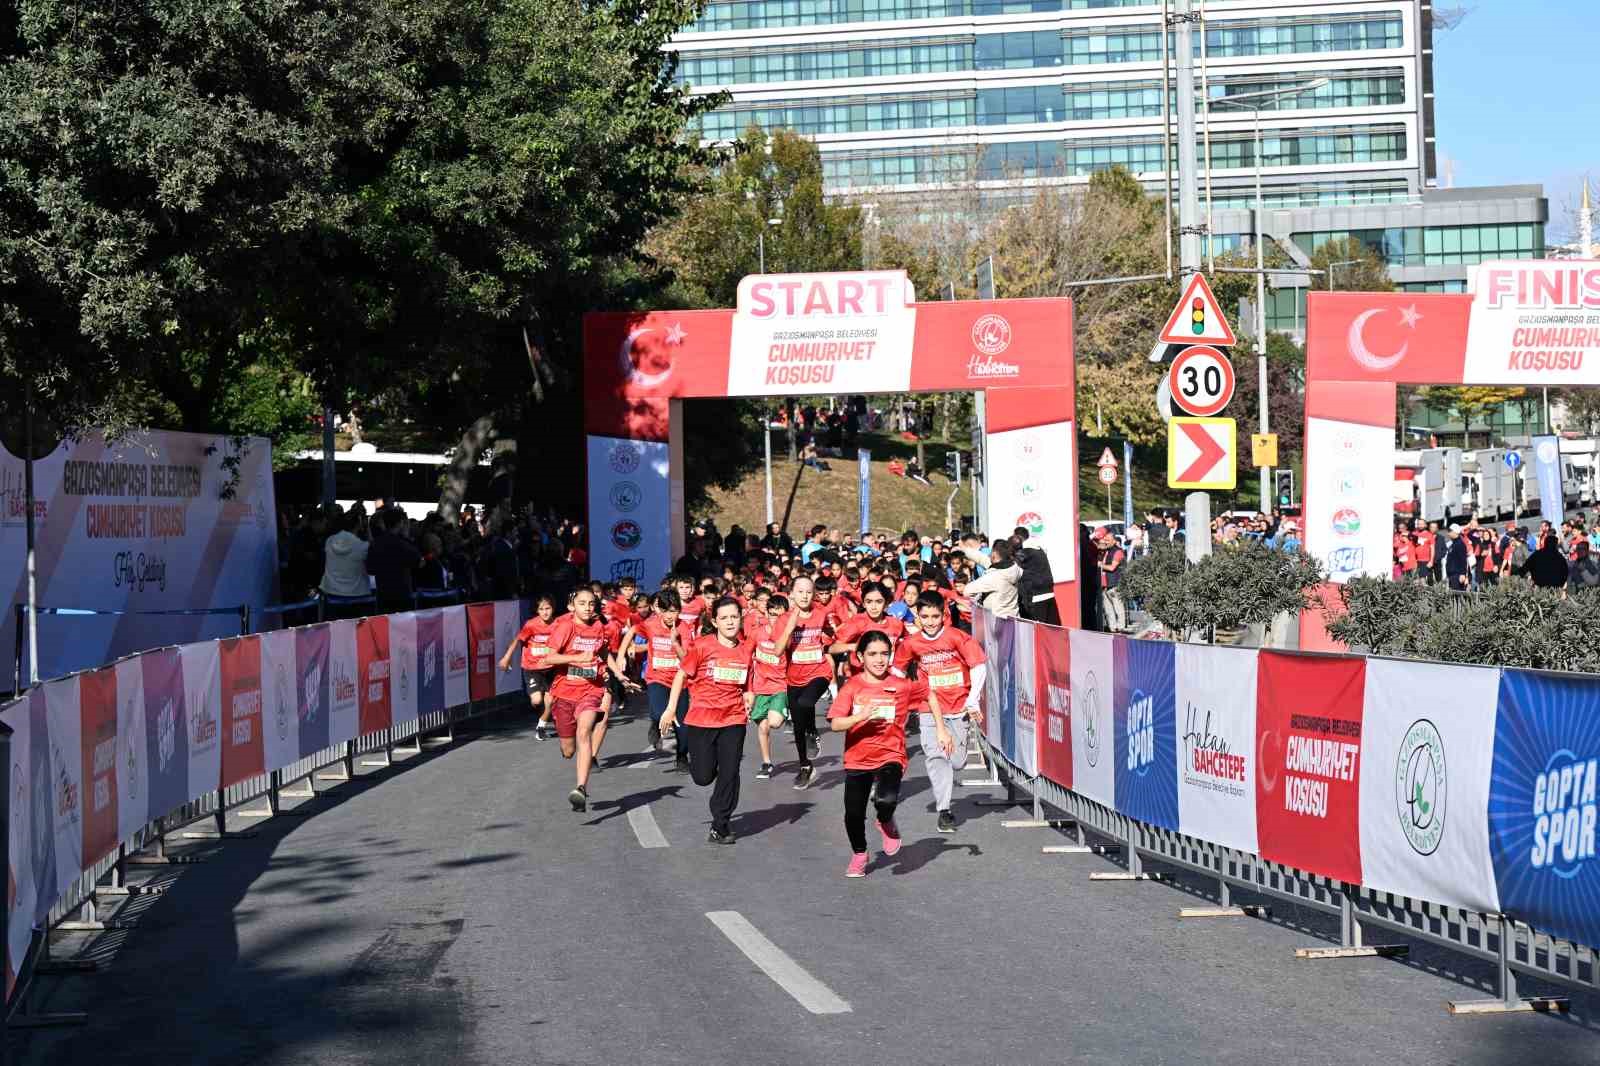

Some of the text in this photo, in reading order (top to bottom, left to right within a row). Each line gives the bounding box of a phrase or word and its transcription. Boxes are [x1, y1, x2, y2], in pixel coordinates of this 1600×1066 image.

[750, 279, 892, 317] START
[765, 365, 834, 386] KOŞUSU
[1182, 366, 1221, 396] 30
[1508, 351, 1583, 371] KOŞUSU
[1127, 726, 1154, 771] SPOR
[1285, 775, 1328, 819] KOŞUSU
[1533, 759, 1598, 817] GOPTA
[1530, 803, 1597, 868] SPOR
